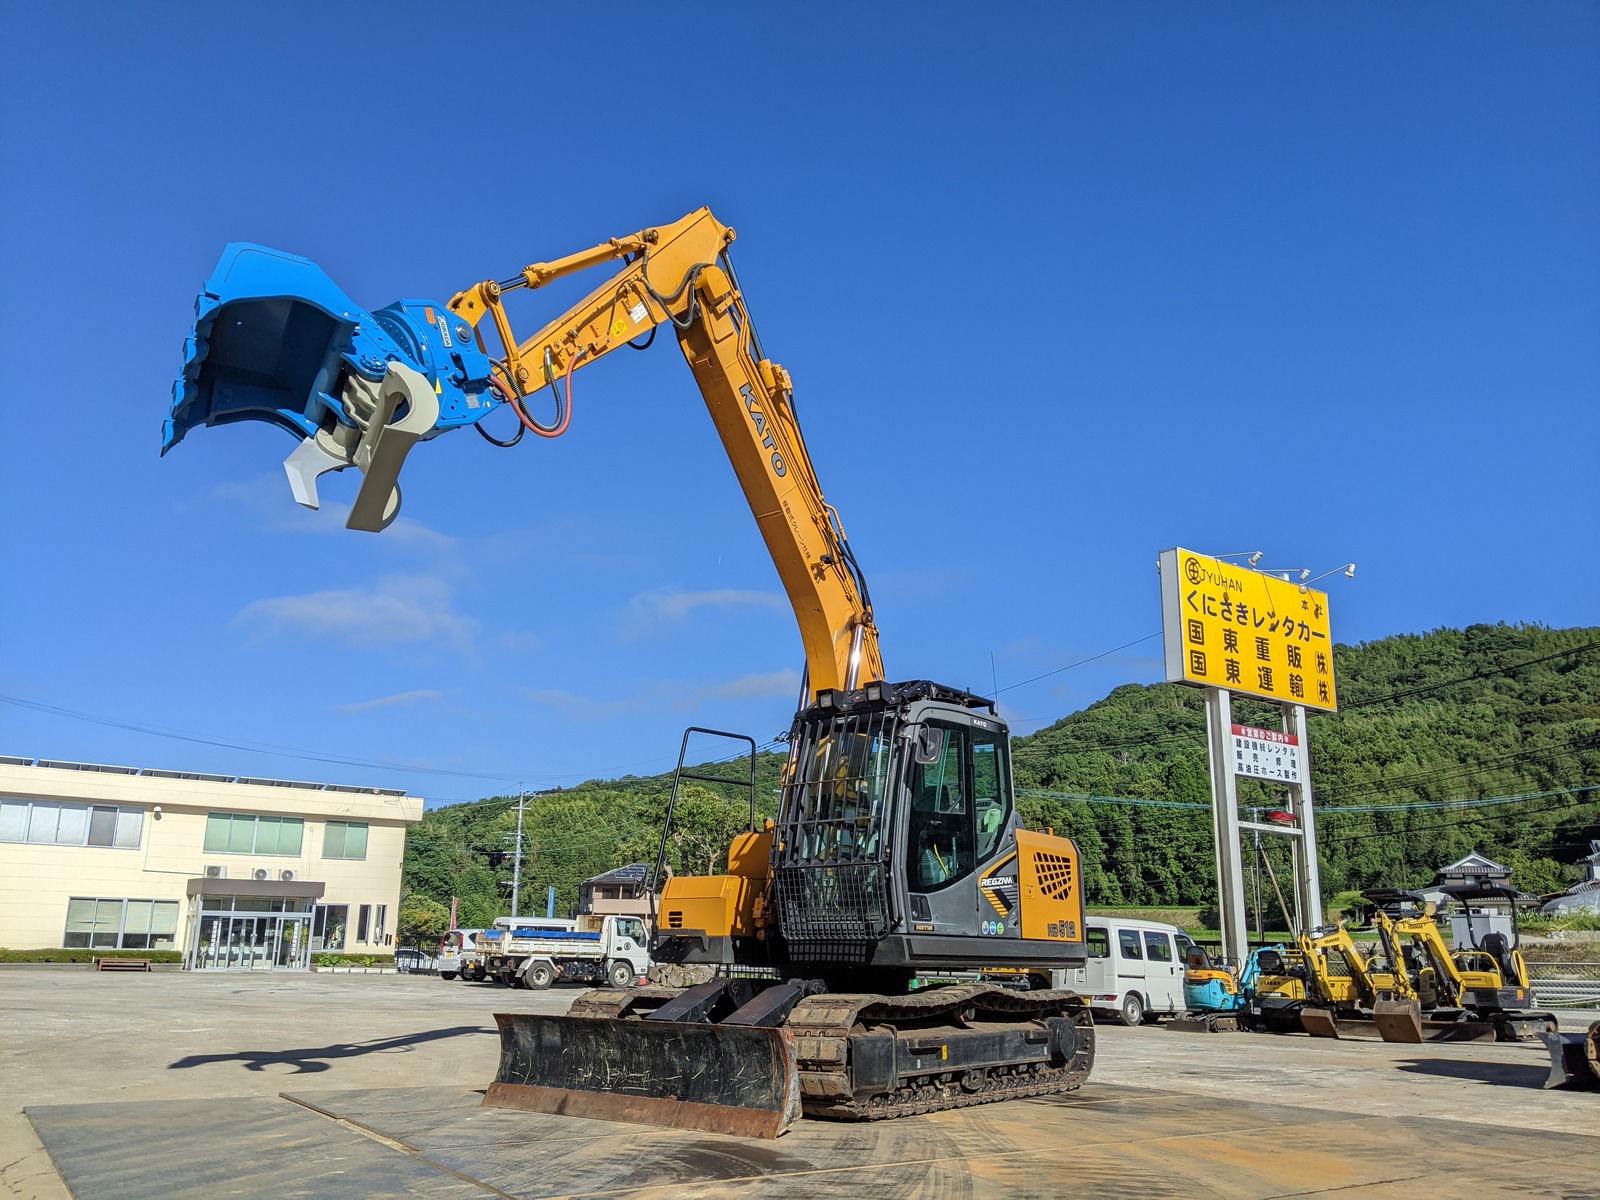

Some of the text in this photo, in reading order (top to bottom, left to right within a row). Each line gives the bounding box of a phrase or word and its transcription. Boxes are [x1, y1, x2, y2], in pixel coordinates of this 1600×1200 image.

[739, 382, 787, 477] KATO
[1200, 569, 1243, 593] JYUHAN
[1187, 590, 1325, 642] くにさきレンタカー
[1301, 600, 1323, 617] 本社
[973, 719, 987, 728] KATO
[1236, 738, 1296, 757] 建設機械レンタル
[1237, 762, 1298, 780] 高油圧ホース製作
